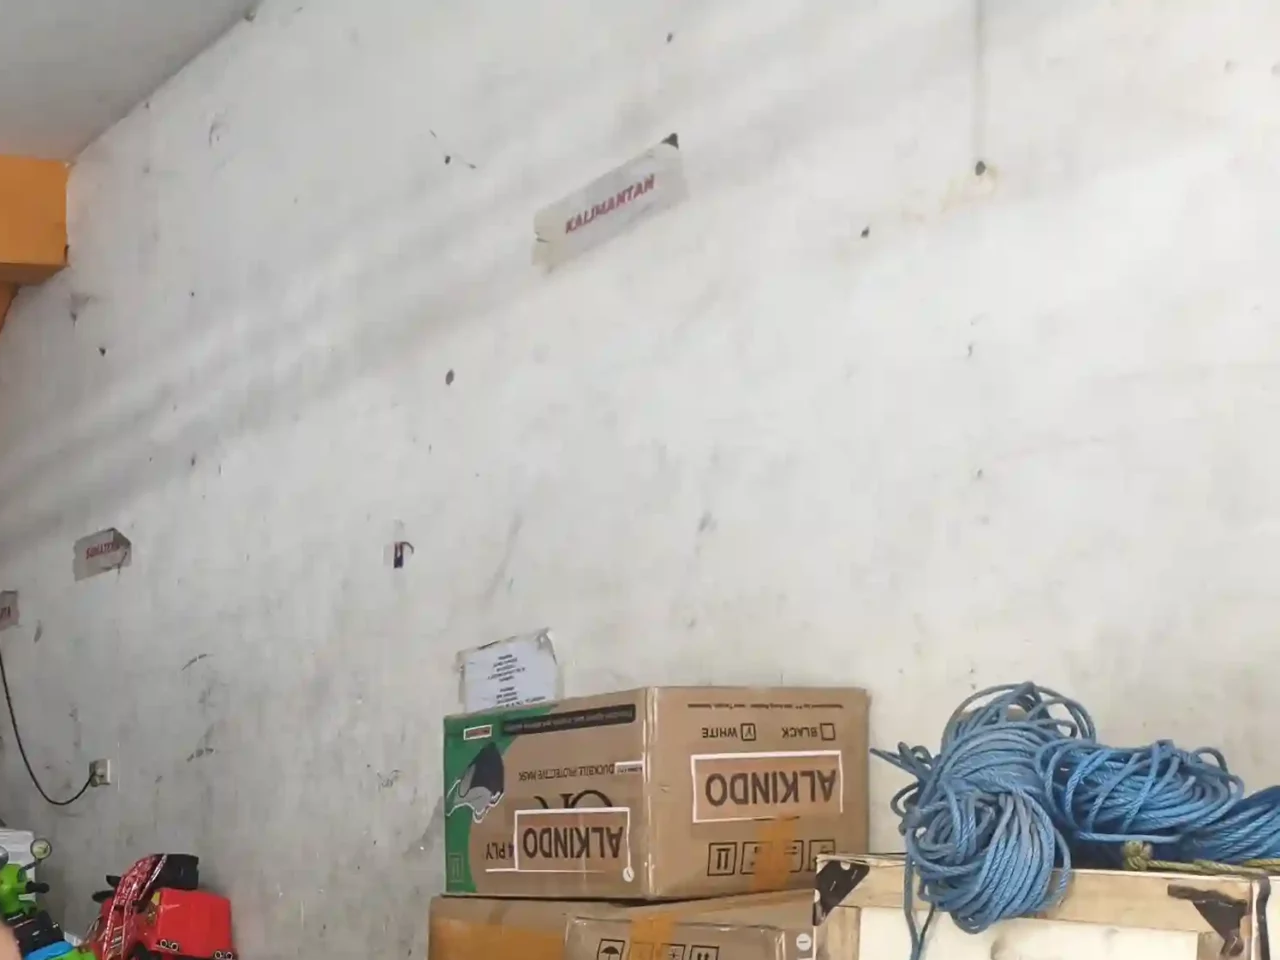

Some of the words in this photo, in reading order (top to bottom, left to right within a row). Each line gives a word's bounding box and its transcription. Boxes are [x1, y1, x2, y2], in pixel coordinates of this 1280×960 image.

[565, 173, 655, 234] KALIMANTAN
[701, 726, 738, 739] WHITE
[781, 726, 818, 739] BLACK
[704, 769, 837, 808] ALKINDO
[485, 841, 506, 860] PLY
[523, 826, 624, 860] ALKINDO
